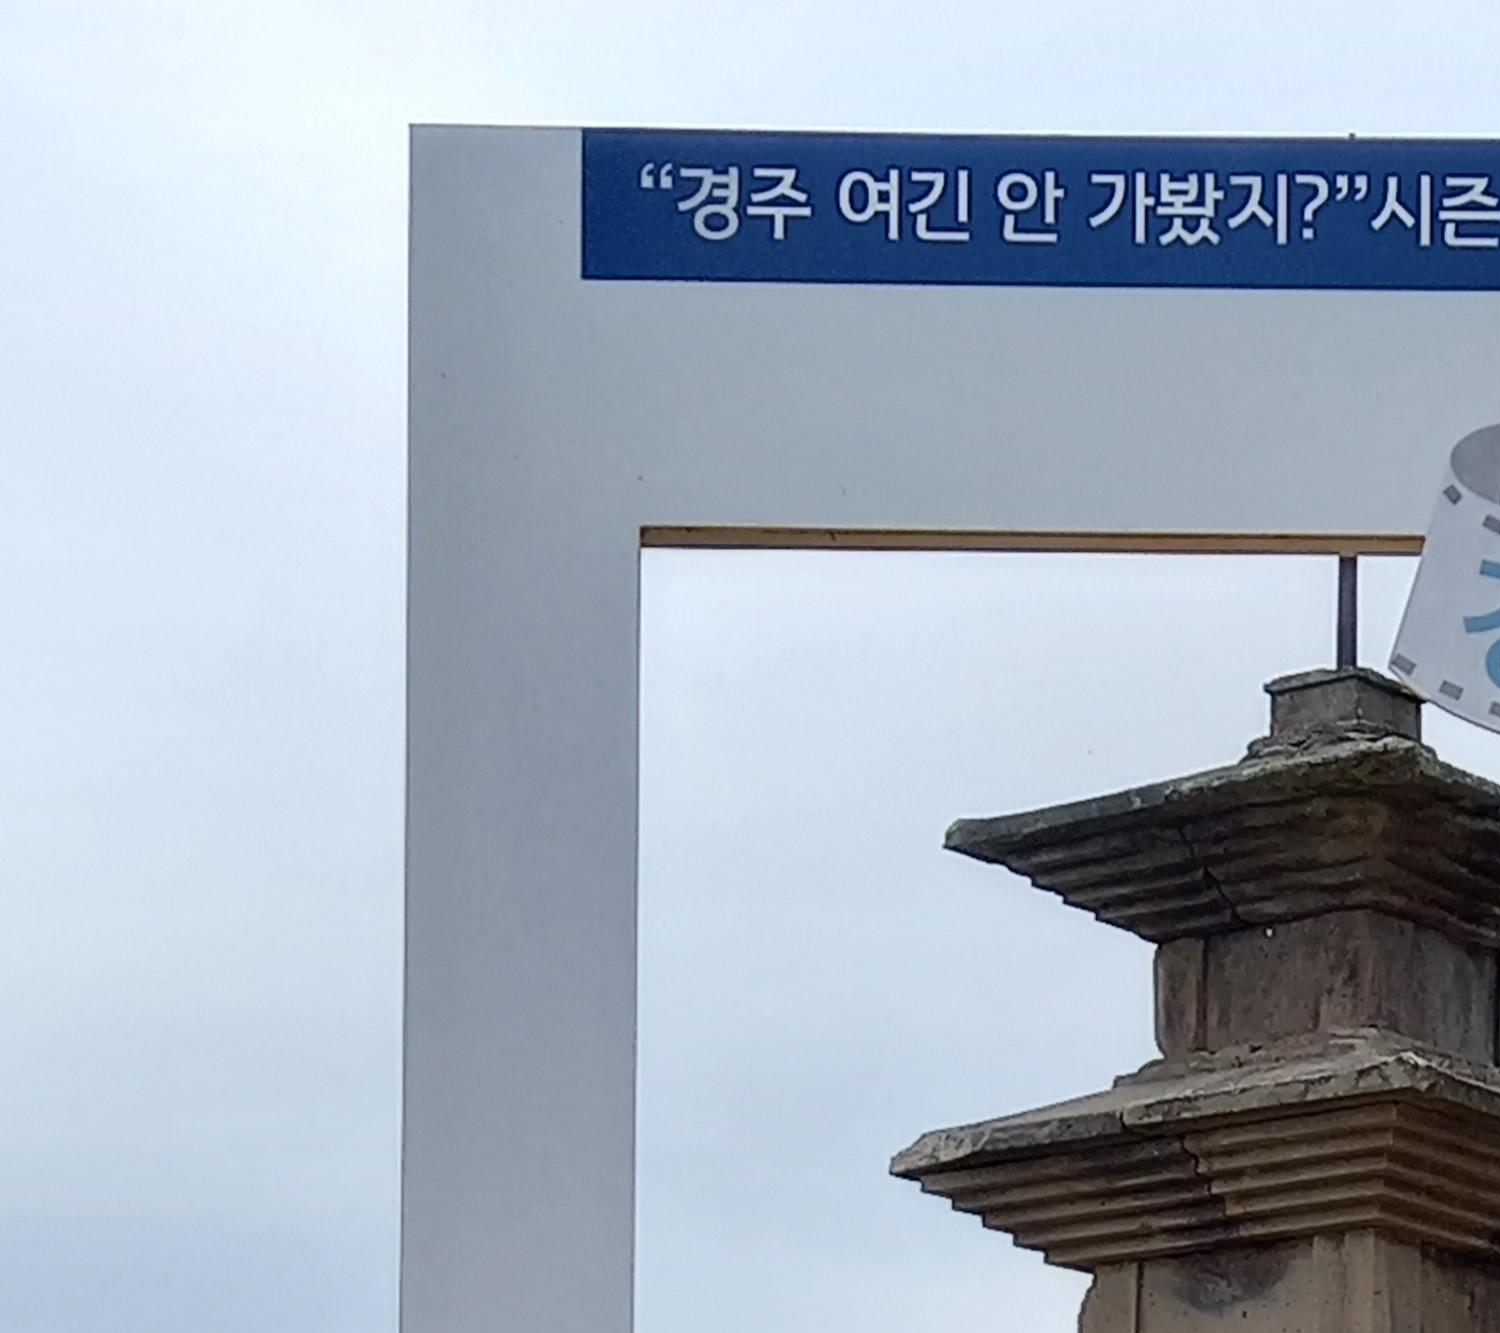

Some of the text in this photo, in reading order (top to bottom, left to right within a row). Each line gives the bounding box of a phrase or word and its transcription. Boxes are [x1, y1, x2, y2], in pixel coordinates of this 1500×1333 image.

[640, 163, 812, 240] “경주
[839, 169, 970, 241] 여긴
[997, 171, 1065, 243] 안
